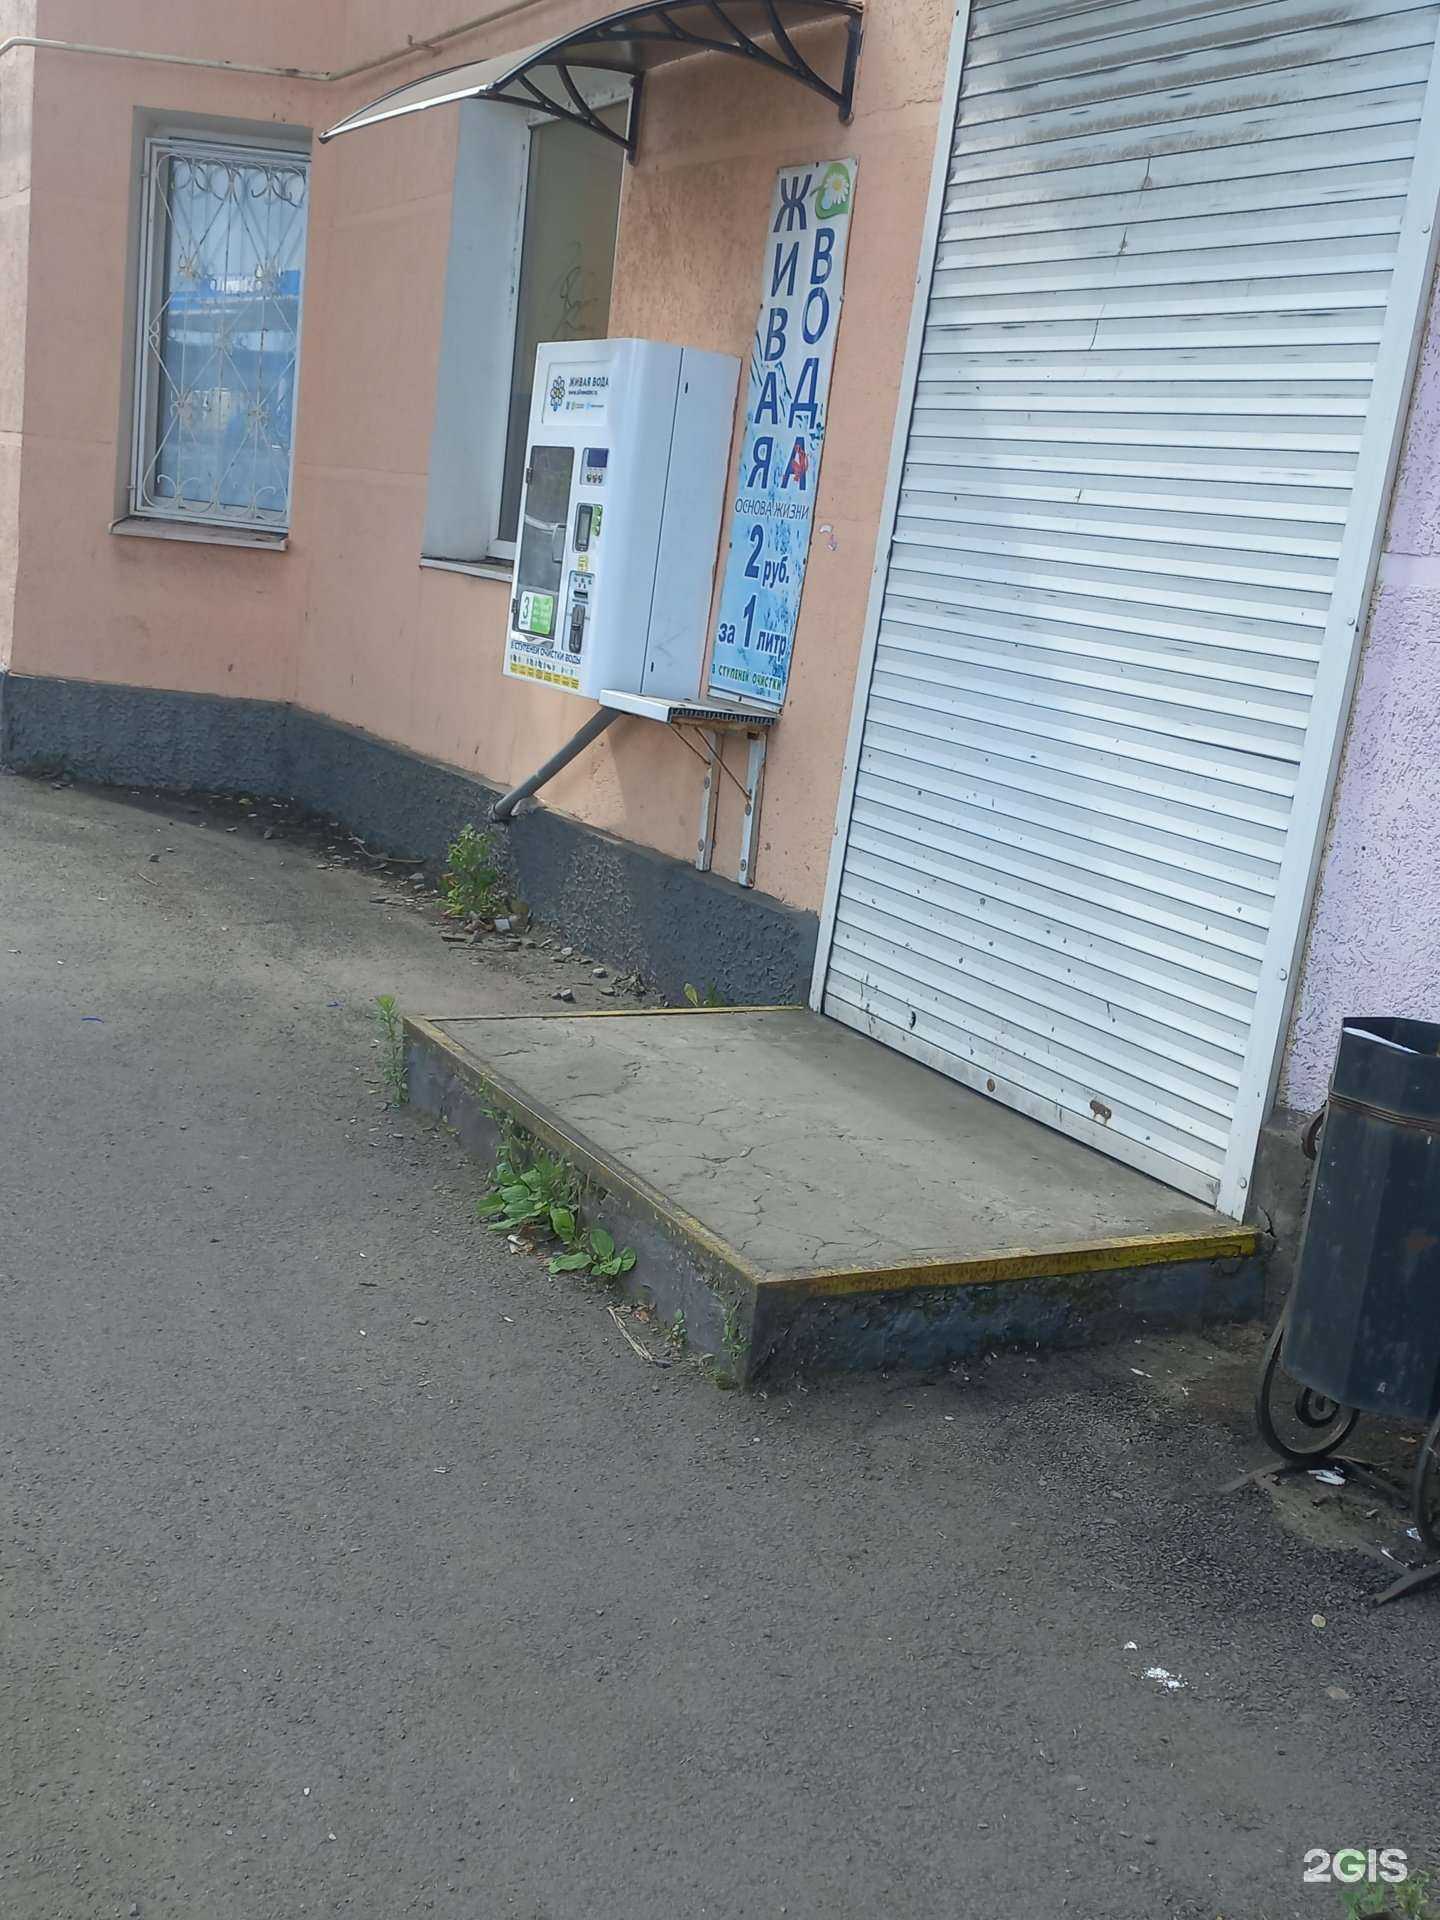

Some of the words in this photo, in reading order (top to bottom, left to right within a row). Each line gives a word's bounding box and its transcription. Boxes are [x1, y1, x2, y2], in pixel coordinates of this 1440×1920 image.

[747, 174, 812, 489] ЖИВАЯ
[781, 228, 834, 491] ВОДА
[592, 376, 609, 388] ВОДА
[735, 498, 772, 518] ОСНОВА
[773, 502, 809, 520] ЖИЗНИ
[744, 524, 764, 578] 2
[762, 555, 790, 588] руб.
[522, 596, 530, 619] 3
[718, 623, 735, 645] за
[743, 594, 757, 648] 1
[751, 672, 782, 690] ОЧИСТКИ
